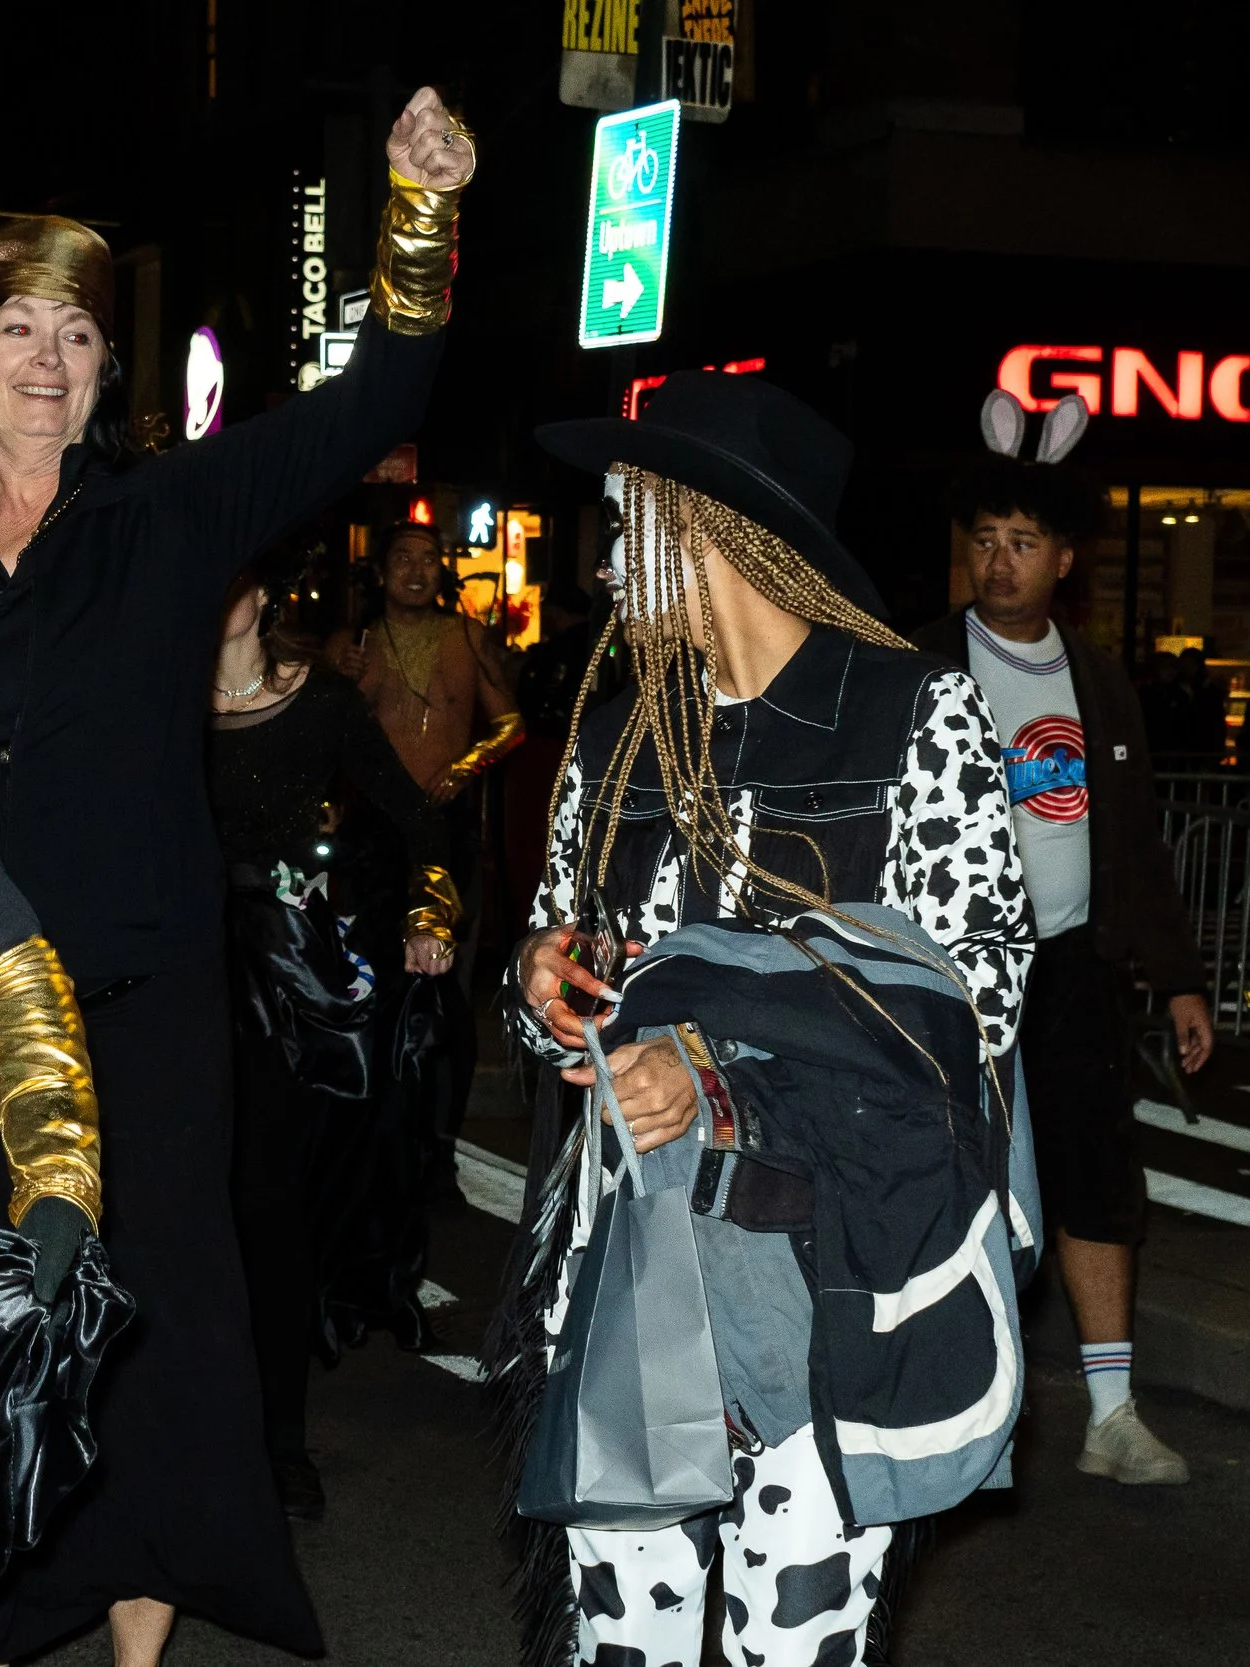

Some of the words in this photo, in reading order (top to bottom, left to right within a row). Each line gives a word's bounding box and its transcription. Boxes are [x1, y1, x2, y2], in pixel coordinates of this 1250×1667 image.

[303, 177, 326, 253] BELL
[599, 218, 658, 261] Uptown
[302, 256, 327, 340] TACO
